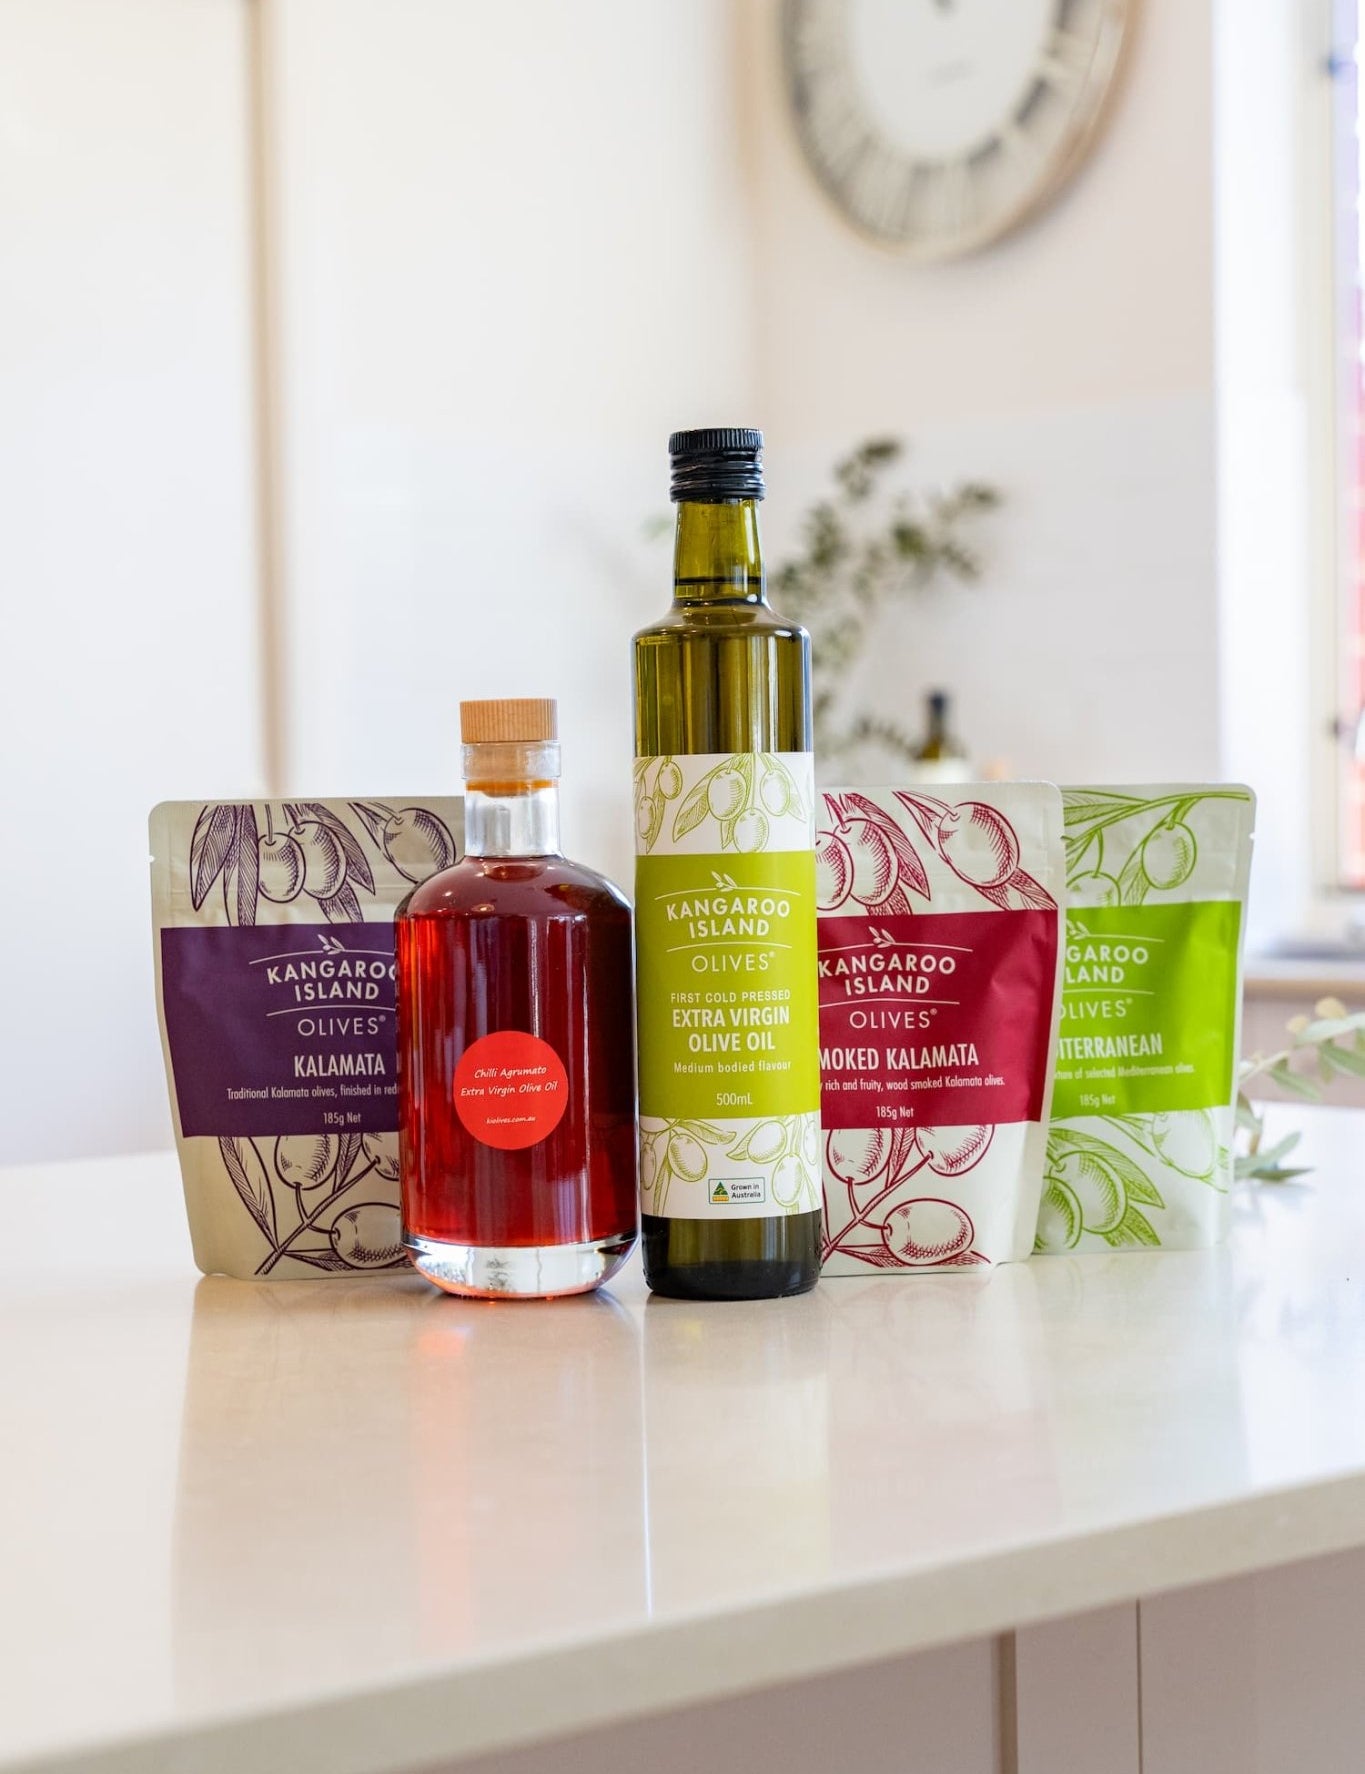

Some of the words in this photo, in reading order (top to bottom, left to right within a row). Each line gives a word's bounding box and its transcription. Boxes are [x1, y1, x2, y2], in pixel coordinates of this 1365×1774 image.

[666, 897, 790, 921] KANGAROO
[689, 918, 770, 938] ISLAND
[1066, 945, 1149, 964] GAROO
[818, 953, 956, 978] KANGAROO
[1065, 965, 1125, 984] LAND
[294, 981, 379, 1002] ISLAND
[845, 974, 930, 996] ISLAND
[671, 992, 700, 1004] FIRST
[705, 992, 737, 1003] COLD
[742, 989, 791, 1002] PRESSED
[672, 1008, 726, 1028] EXTRA
[730, 1006, 790, 1027] VIRGIN
[688, 1033, 741, 1053] OLIVE
[747, 1031, 776, 1051] OIL
[1056, 1033, 1163, 1060] ITERRANEAN
[294, 1053, 386, 1077] KALAMATA
[673, 1062, 714, 1073] Medium
[718, 1061, 755, 1073] bodied
[758, 1060, 791, 1071] flavour
[819, 1047, 879, 1071] MOKED
[886, 1043, 979, 1070] KALAMATA
[474, 1068, 498, 1079] Chilli
[500, 1066, 547, 1079] Agrumato
[227, 1087, 268, 1101] Traditional
[271, 1086, 309, 1098] Kalamata
[311, 1085, 338, 1098] olives,
[340, 1084, 371, 1096] finished
[374, 1084, 382, 1095] in
[461, 1088, 484, 1097] Extra
[488, 1085, 515, 1098] Virgin
[519, 1083, 542, 1093] Olive
[544, 1081, 558, 1091] Oil
[825, 1079, 840, 1091] rich
[842, 1079, 858, 1091] and
[860, 1079, 884, 1093] fruity,
[886, 1078, 909, 1090] wood
[910, 1077, 943, 1089] smoked
[945, 1075, 982, 1087] Kalamata
[716, 1092, 753, 1106] 500mL
[1080, 1094, 1100, 1108] 185g
[1102, 1094, 1116, 1105] Net
[323, 1112, 345, 1126] 185g
[347, 1112, 361, 1123] Net
[876, 1106, 897, 1120] 185g
[900, 1106, 914, 1118] Net
[731, 1191, 761, 1199] Australia
